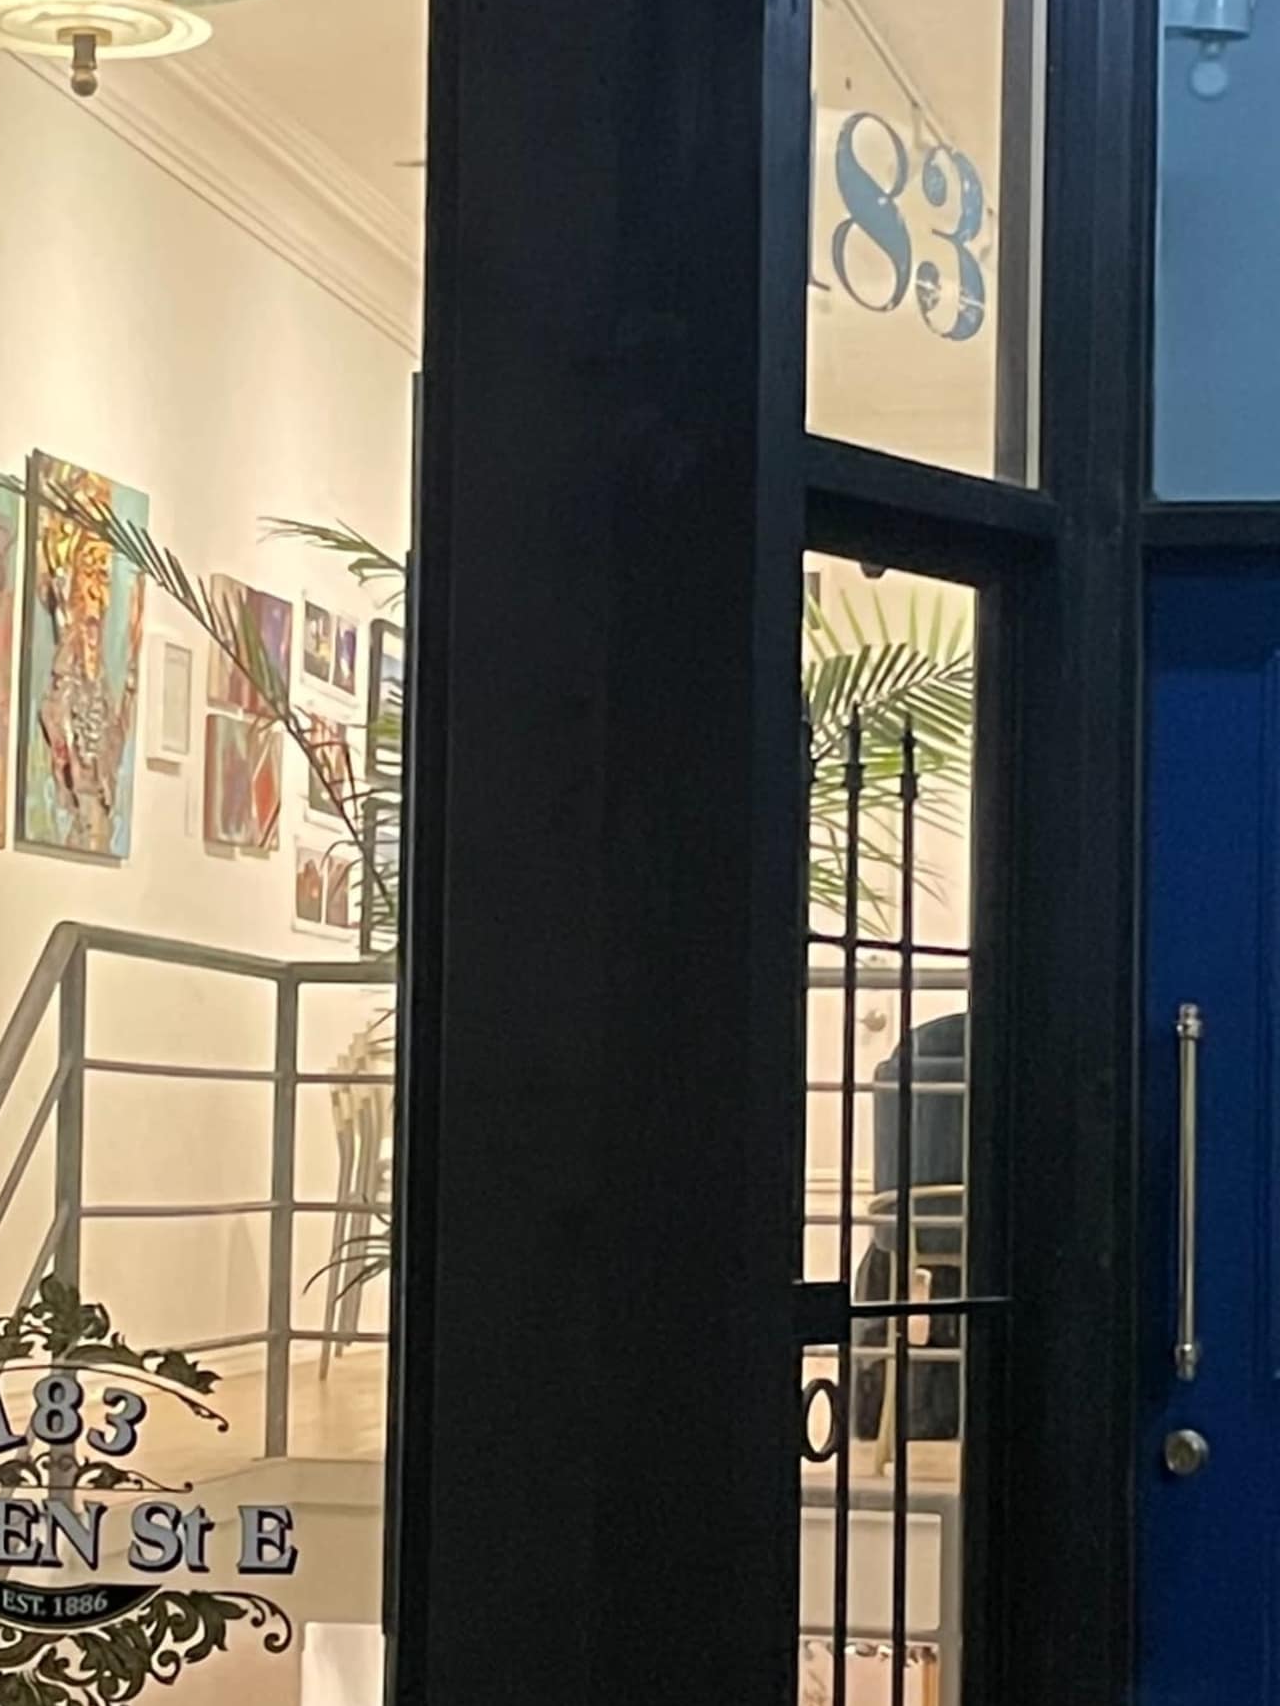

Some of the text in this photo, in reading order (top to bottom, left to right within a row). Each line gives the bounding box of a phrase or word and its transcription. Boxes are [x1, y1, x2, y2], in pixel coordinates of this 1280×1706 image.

[812, 112, 985, 341] 83
[128, 1500, 215, 1572] St
[237, 1503, 298, 1575] E
[2, 1589, 109, 1617] EST. 1886
